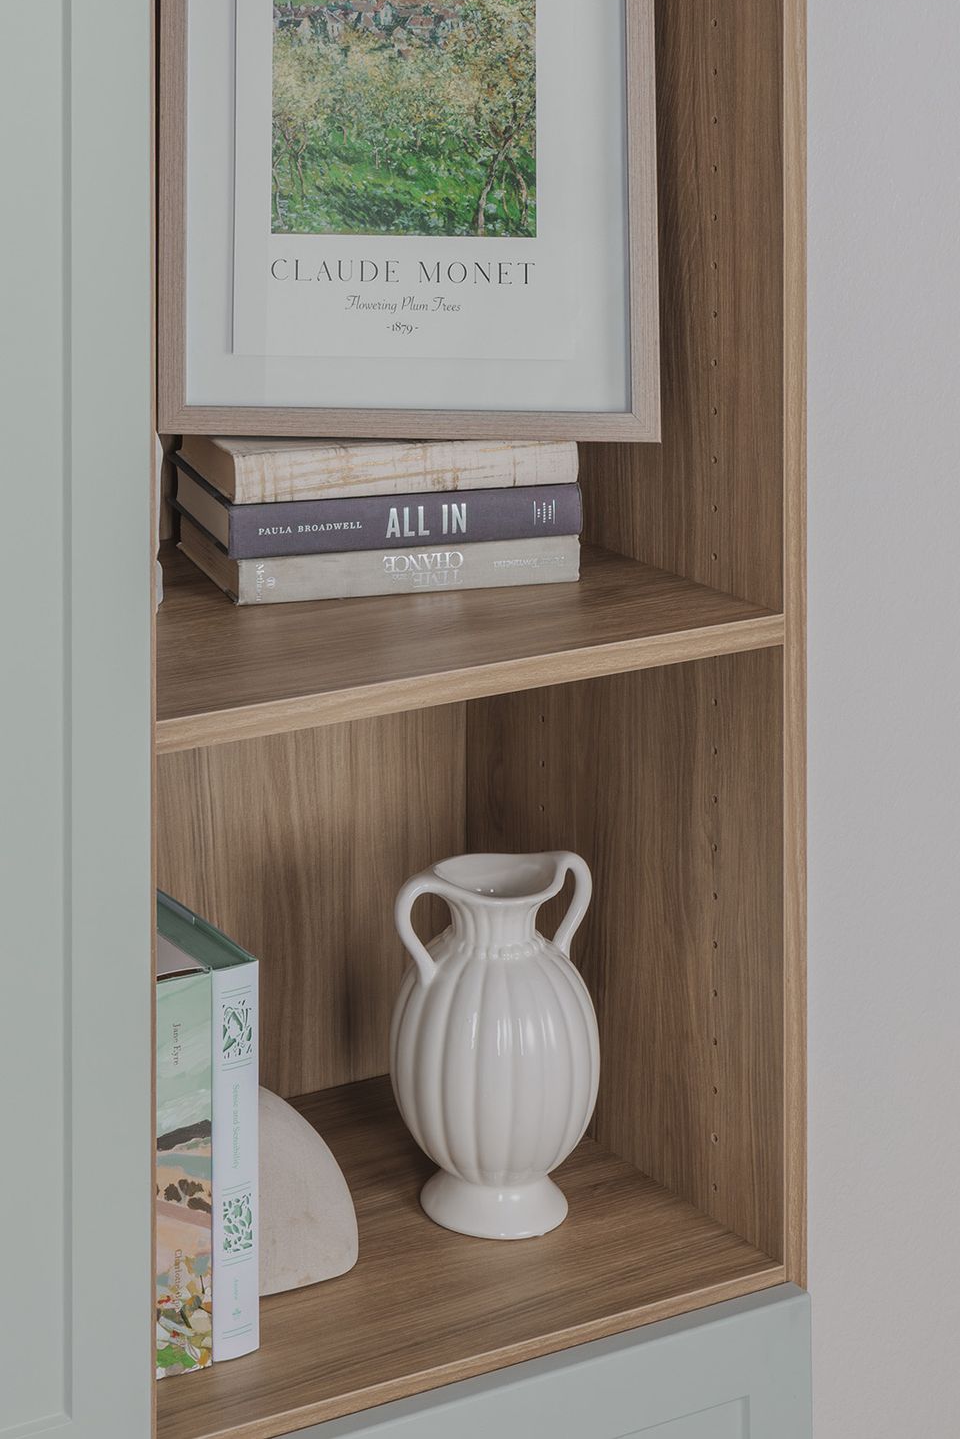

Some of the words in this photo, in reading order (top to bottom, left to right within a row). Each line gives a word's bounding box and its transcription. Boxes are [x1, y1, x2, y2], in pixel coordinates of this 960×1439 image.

[270, 258, 400, 283] CLAUDE
[418, 260, 536, 285] MONET
[344, 294, 398, 314] Flowering
[401, 295, 429, 312] Plum
[431, 296, 461, 312] Trees
[258, 525, 292, 536] PAULA
[297, 521, 363, 533] BROADWELL
[385, 505, 431, 539] ALL
[441, 502, 467, 535] IN
[382, 551, 464, 574] CHANCE
